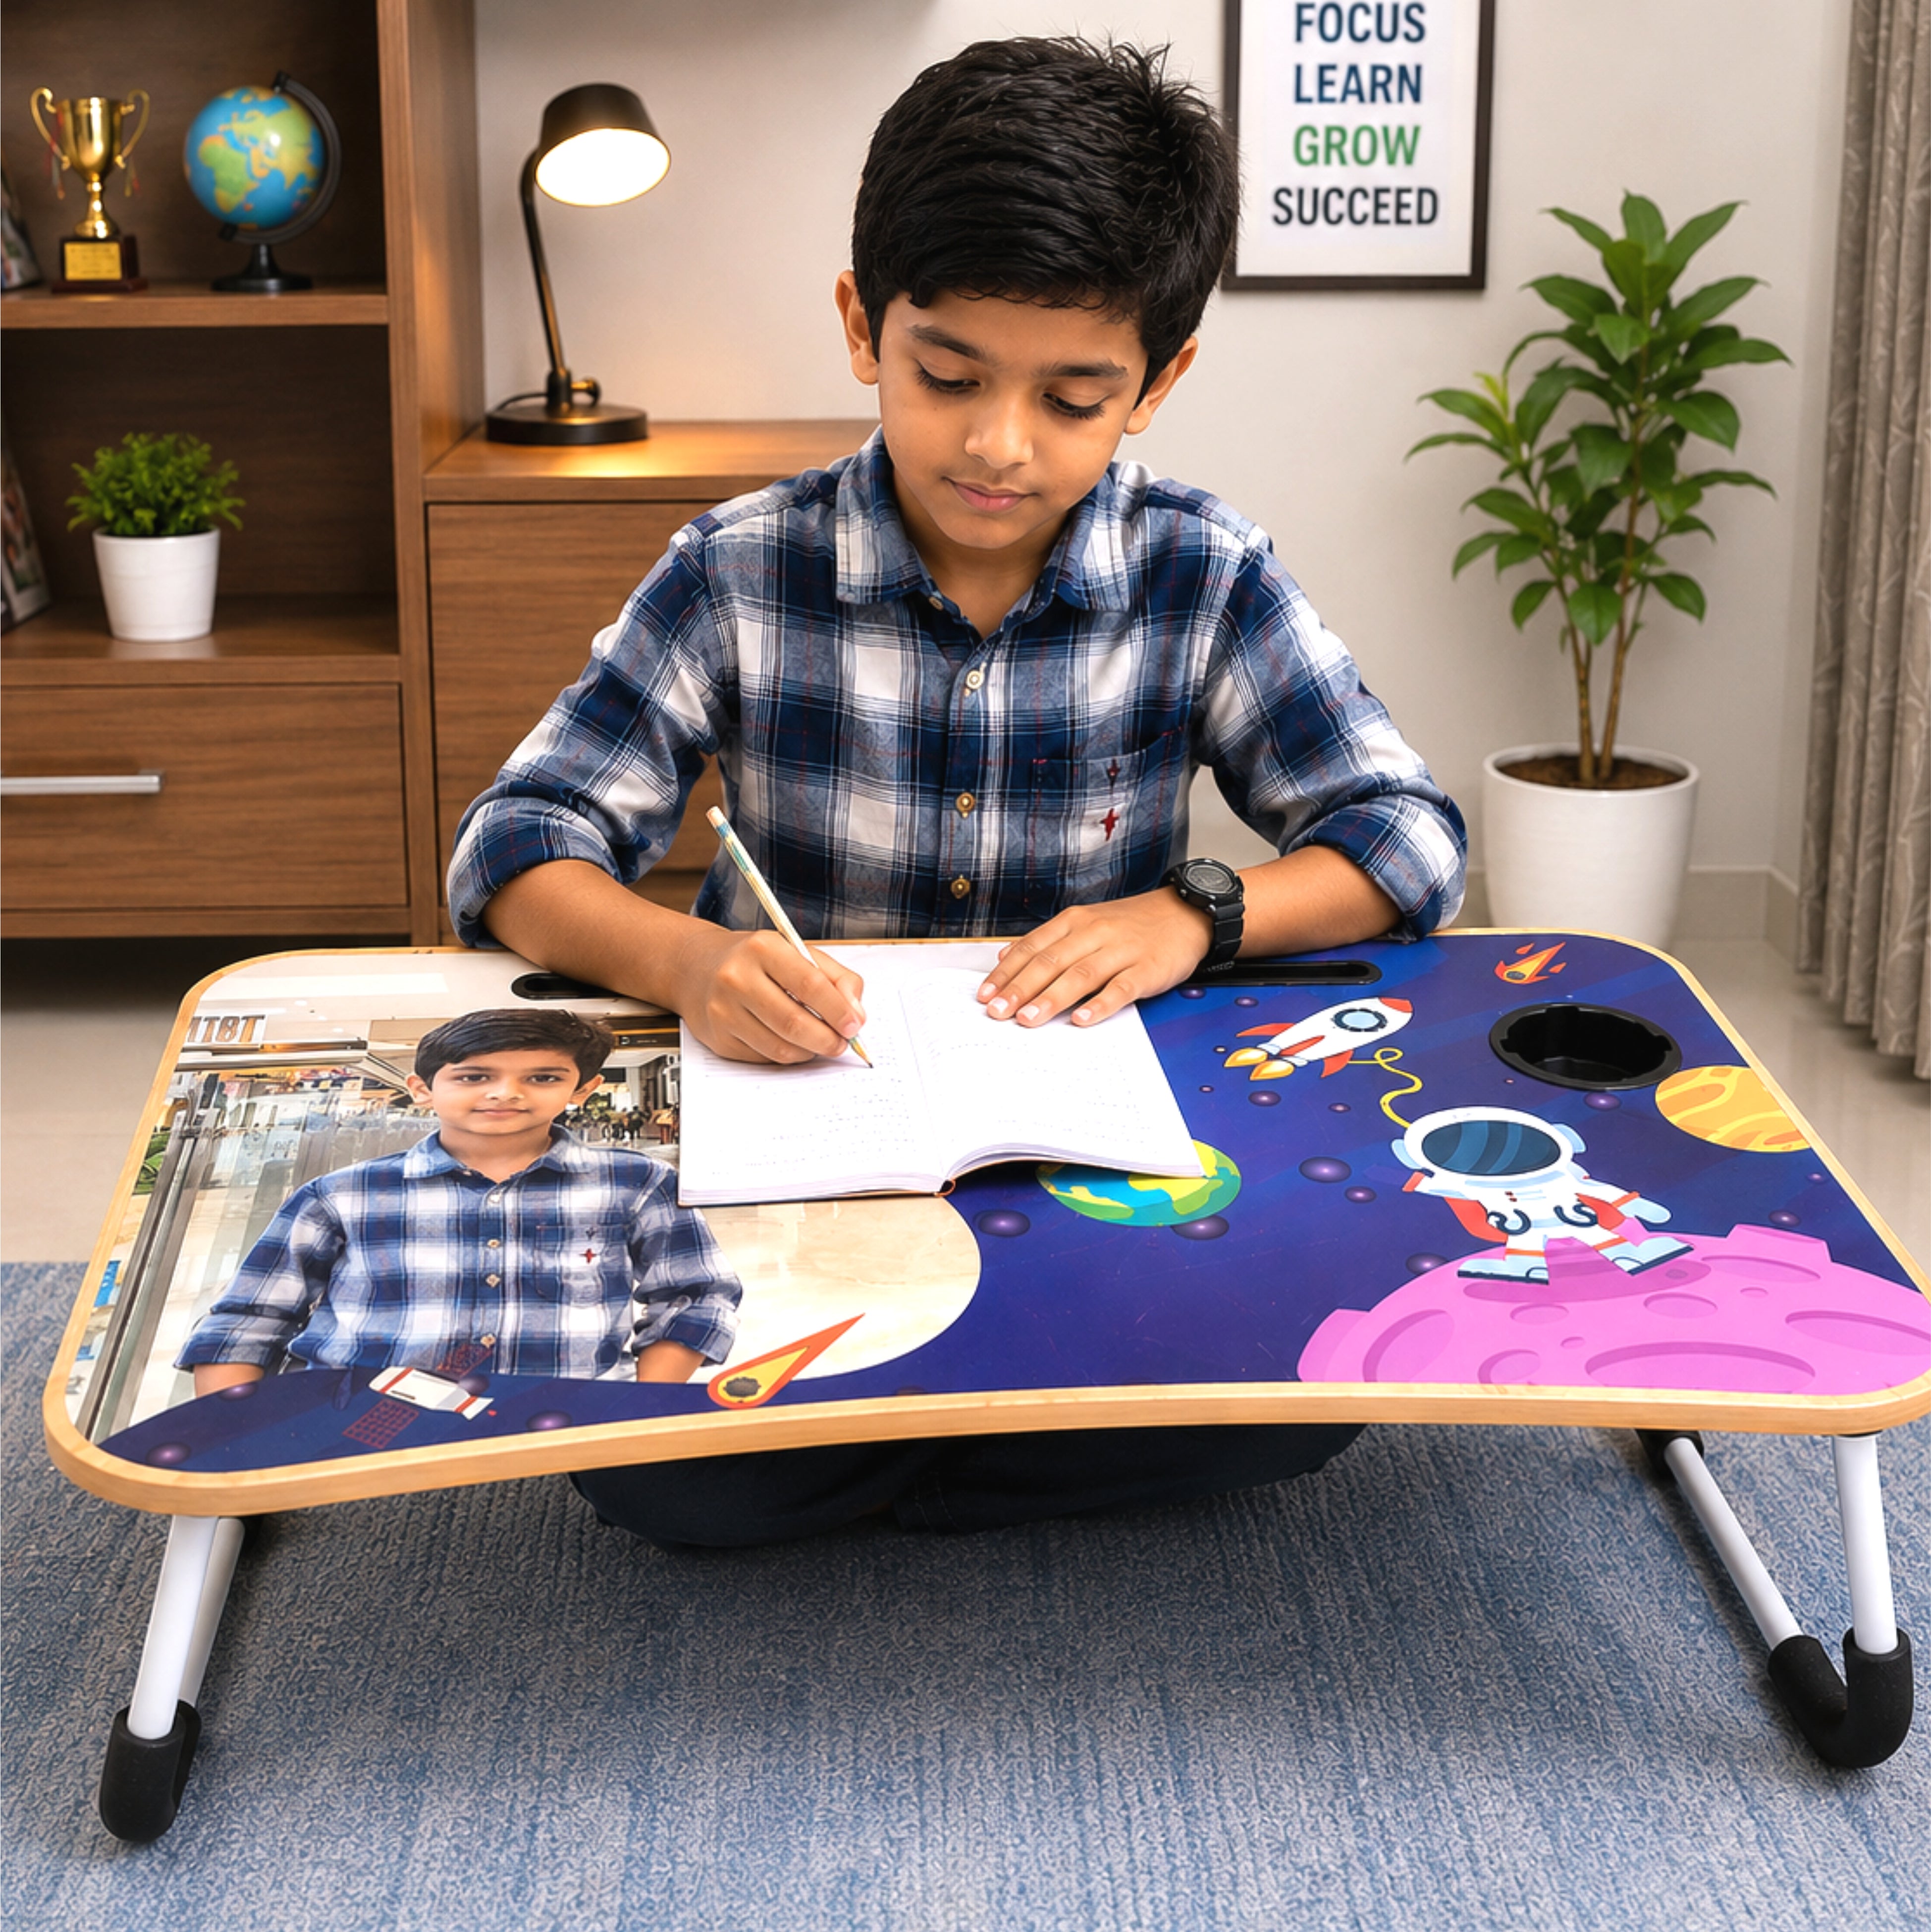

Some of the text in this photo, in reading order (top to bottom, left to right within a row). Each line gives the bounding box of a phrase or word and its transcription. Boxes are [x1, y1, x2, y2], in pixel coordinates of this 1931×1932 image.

[1295, 2, 1426, 43] FOCUS
[1294, 63, 1422, 104] LEARN
[1293, 125, 1421, 166] GROW
[1272, 187, 1439, 226] SUCCEED
